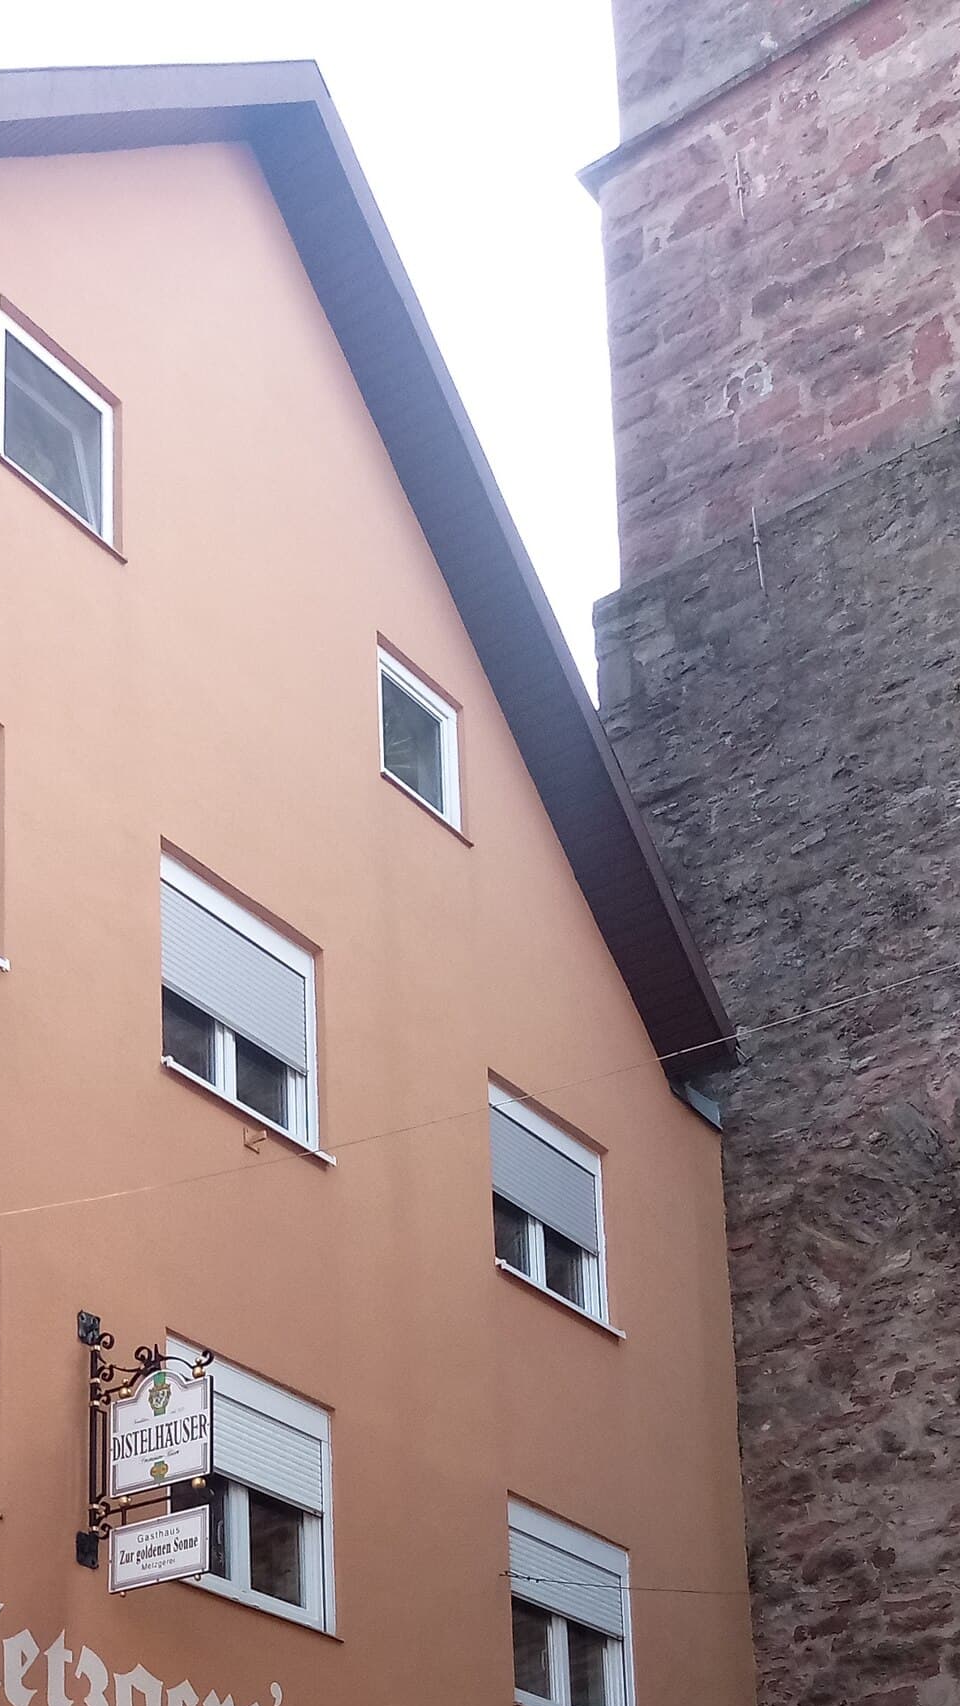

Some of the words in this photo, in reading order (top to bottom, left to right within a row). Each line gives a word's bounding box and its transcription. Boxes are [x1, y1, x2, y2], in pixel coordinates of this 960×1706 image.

[113, 1413, 207, 1462] DISTELHÄUSER
[137, 1527, 180, 1543] Gasthaus
[120, 1550, 135, 1565] Zur
[136, 1543, 171, 1564] goldenen
[173, 1536, 198, 1552] Sonne
[141, 1558, 176, 1570] Metzgerei
